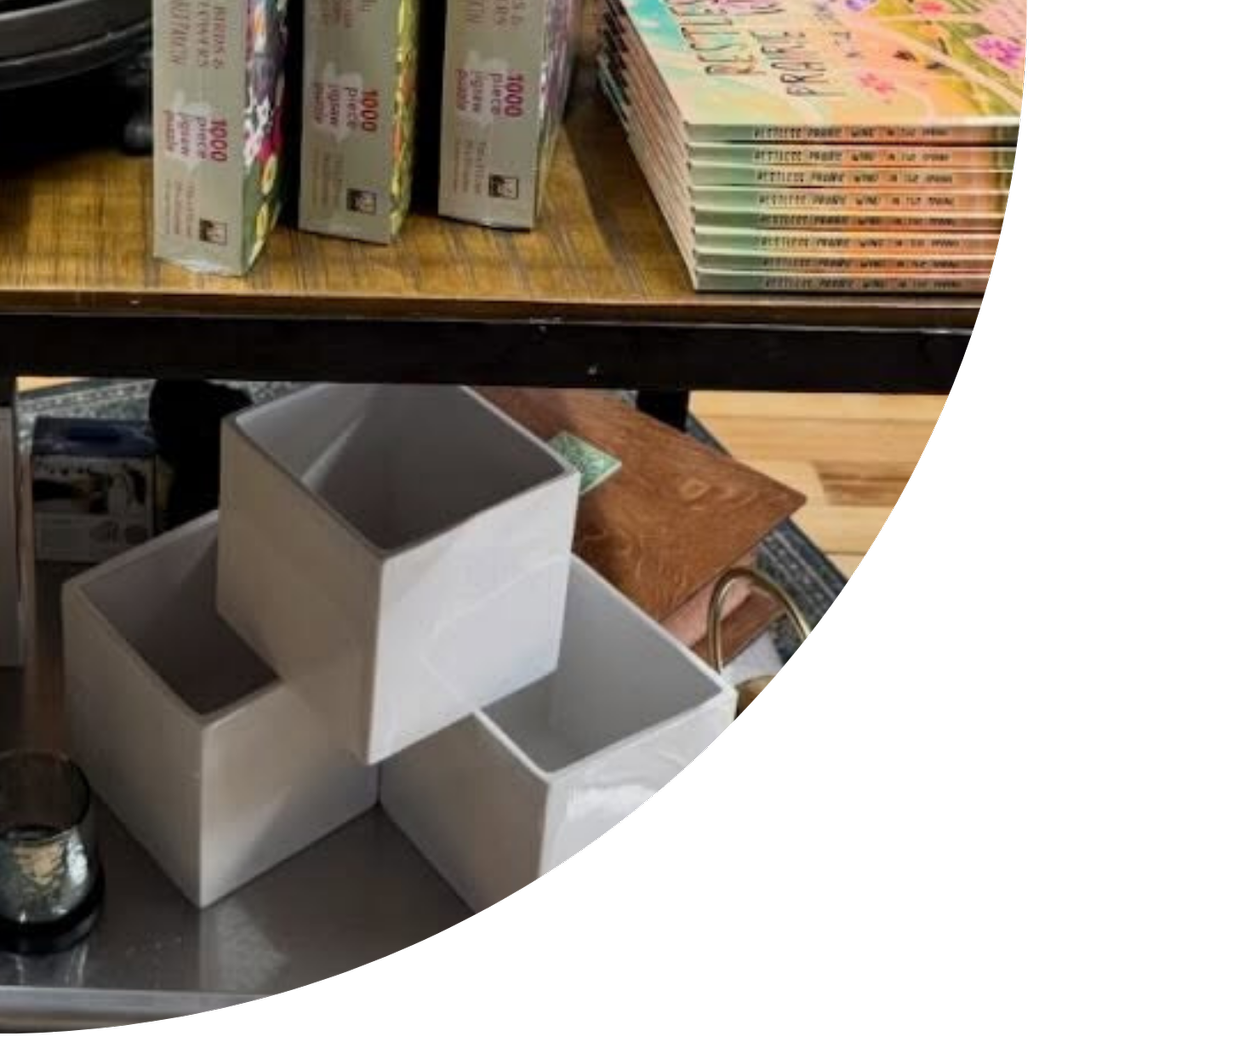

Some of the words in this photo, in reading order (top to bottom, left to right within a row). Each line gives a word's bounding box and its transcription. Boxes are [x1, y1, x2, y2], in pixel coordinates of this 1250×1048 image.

[344, 86, 358, 130] piece
[361, 89, 379, 133] 1000
[469, 69, 483, 112] jigsaw
[488, 72, 504, 116] piece
[504, 74, 524, 118] 1000
[196, 115, 207, 160] piece
[210, 120, 228, 162] 1000
